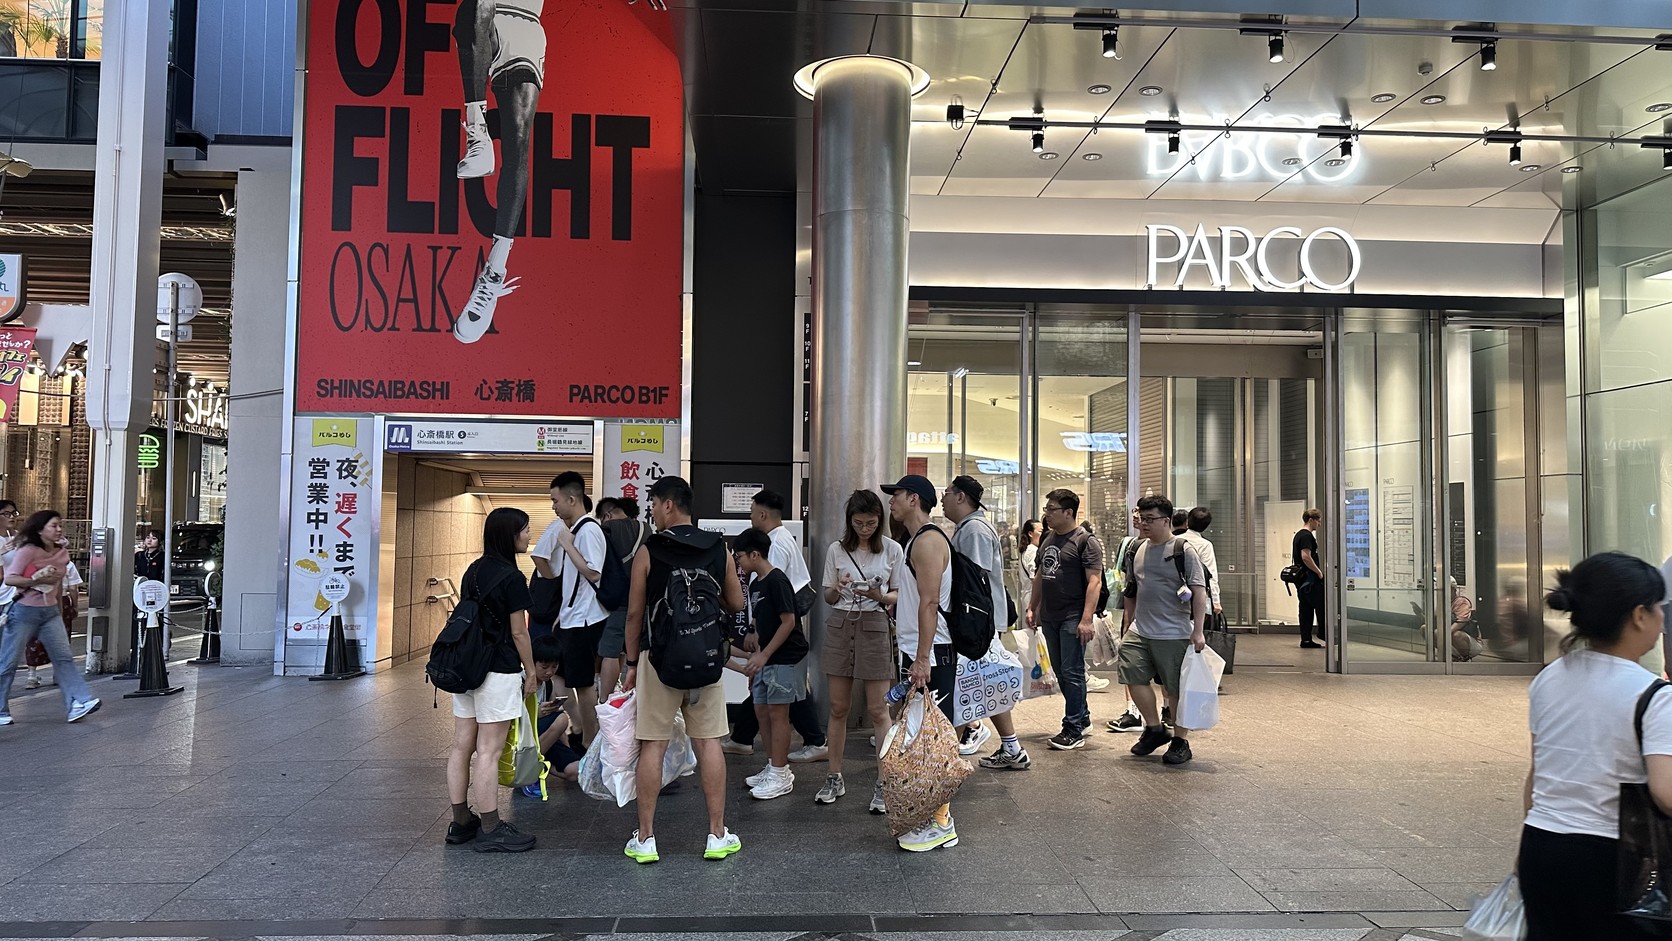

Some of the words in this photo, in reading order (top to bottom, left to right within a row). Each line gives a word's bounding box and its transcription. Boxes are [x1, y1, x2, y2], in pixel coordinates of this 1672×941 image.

[335, 0, 452, 97] OF
[1145, 223, 1361, 292] PARCO
[316, 378, 450, 400] SHINSAIBASHI
[474, 379, 536, 402] 心斎橋
[568, 384, 636, 404] PARCO
[638, 386, 670, 405] B1F
[417, 430, 455, 439] 心斎橋駅
[998, 665, 1015, 676] Store
[962, 681, 980, 690] NAMCO
